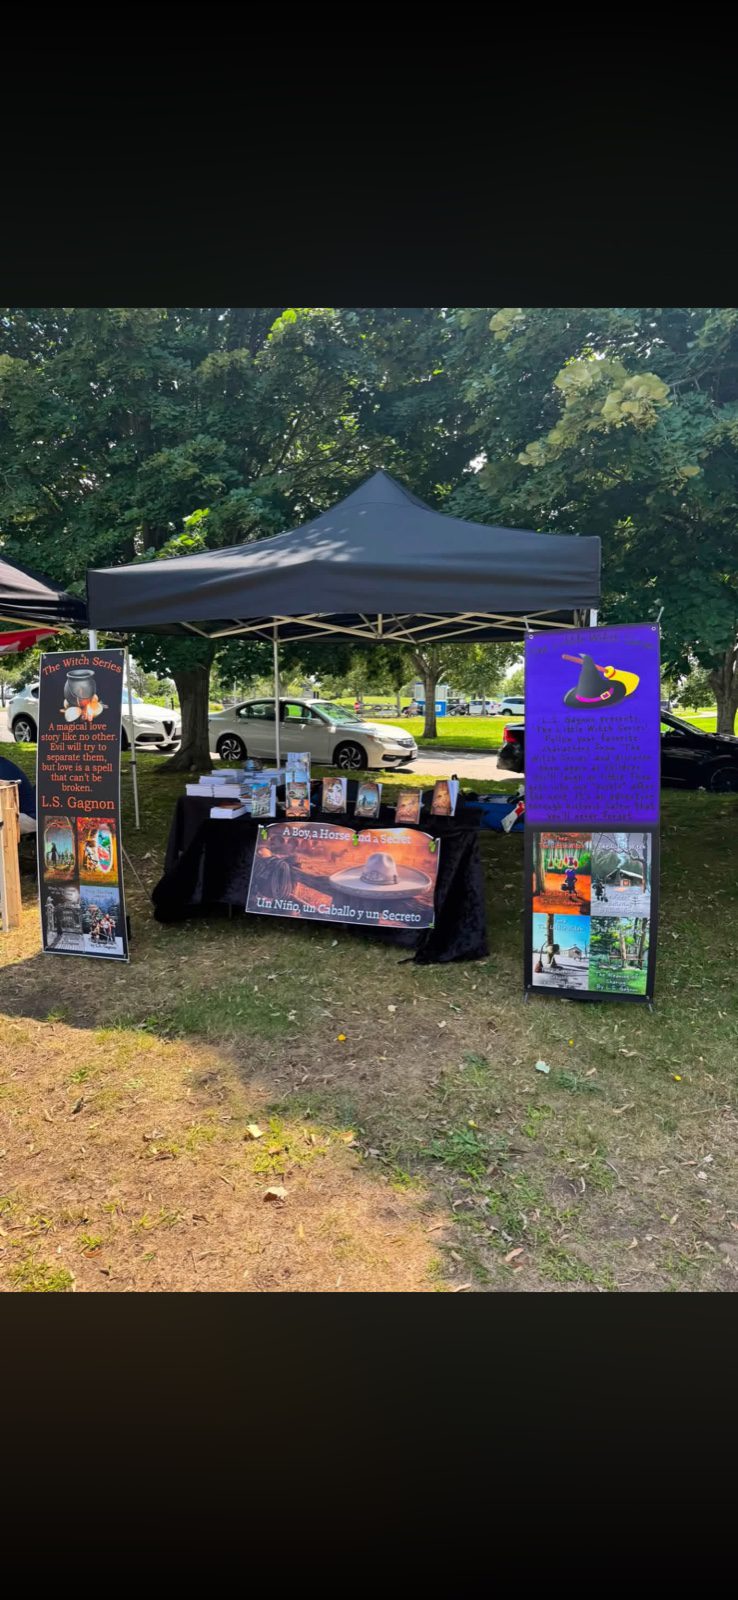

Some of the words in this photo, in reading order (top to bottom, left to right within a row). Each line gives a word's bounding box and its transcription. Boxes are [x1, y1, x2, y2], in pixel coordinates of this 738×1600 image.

[43, 662, 60, 676] The
[63, 656, 89, 668] Witch
[92, 656, 122, 674] Series
[57, 722, 87, 732] magical
[90, 722, 107, 730] love
[41, 734, 60, 742] story
[62, 733, 76, 741] like
[92, 733, 118, 741] other.
[84, 744, 96, 753] try
[47, 754, 80, 763] separate
[83, 753, 107, 762] them,
[58, 763, 73, 772] love
[76, 764, 82, 772] is
[92, 763, 112, 774] spell
[51, 774, 67, 782] that
[70, 774, 89, 782] can't
[92, 774, 102, 782] be
[62, 783, 93, 792] broken.
[42, 796, 63, 808] L.S.
[68, 797, 115, 811] Gagnon
[283, 828, 290, 836] A
[320, 829, 350, 841] Horse
[381, 834, 412, 844] Secret
[256, 897, 272, 908] Un
[274, 899, 300, 913] Niño,
[303, 904, 316, 913] un
[317, 903, 356, 917] Caballo
[356, 909, 364, 921] y
[366, 910, 380, 920] un
[381, 909, 421, 922] Secreto
